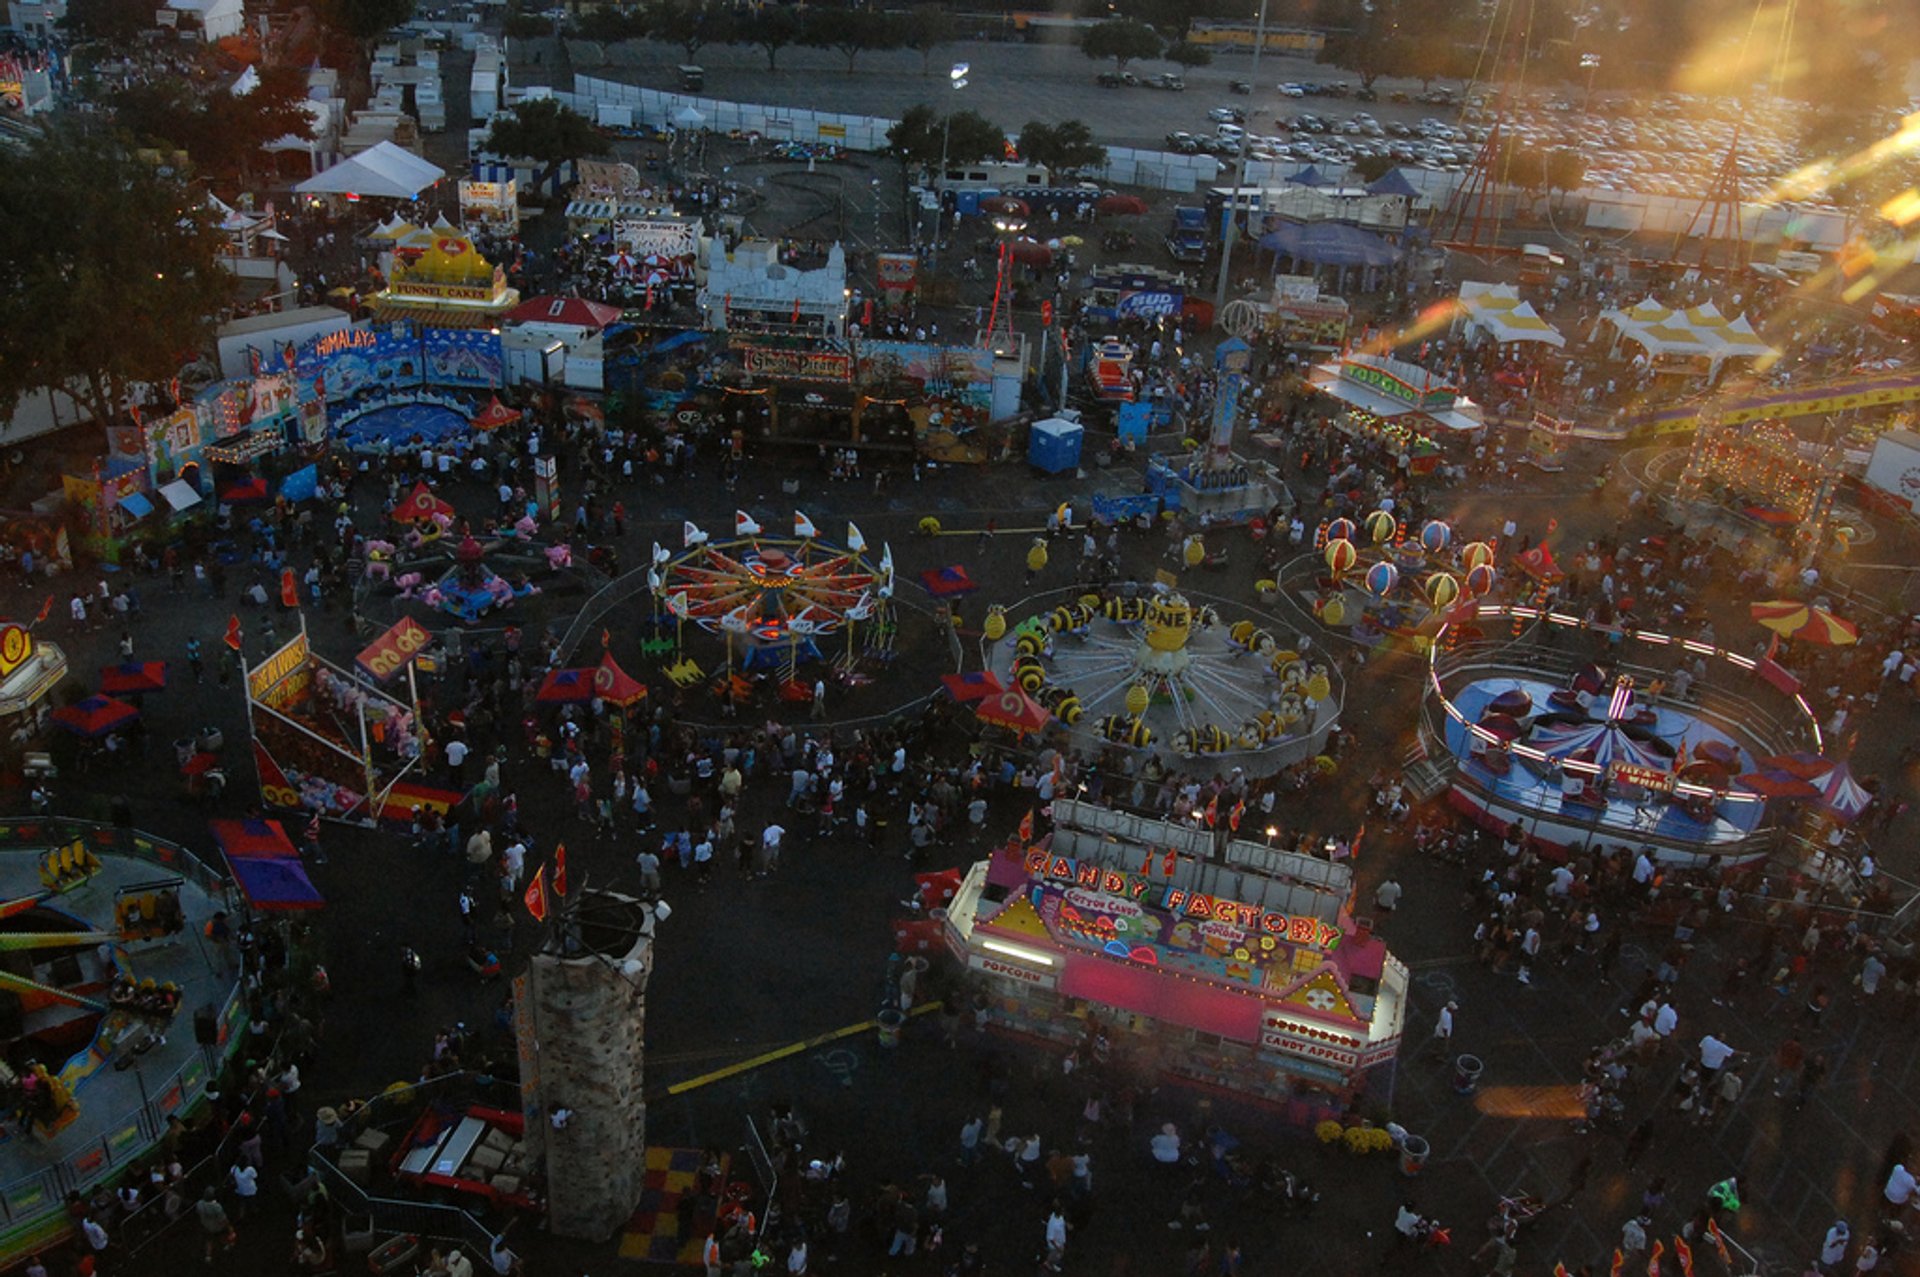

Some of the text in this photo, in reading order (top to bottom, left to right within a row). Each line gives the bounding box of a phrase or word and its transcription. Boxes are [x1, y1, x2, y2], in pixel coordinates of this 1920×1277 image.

[397, 284, 485, 299] FUNNEL CAKES
[1130, 293, 1172, 307] BUD
[316, 328, 377, 357] HIMALAYA
[1027, 852, 1342, 947] CANDY FACTORY
[1067, 890, 1105, 909] COTTON
[1107, 901, 1139, 917] CANDY
[1202, 924, 1243, 942] POPCORN
[982, 960, 1041, 983] POPCORN
[1266, 1035, 1354, 1064] CANDY APPLES
